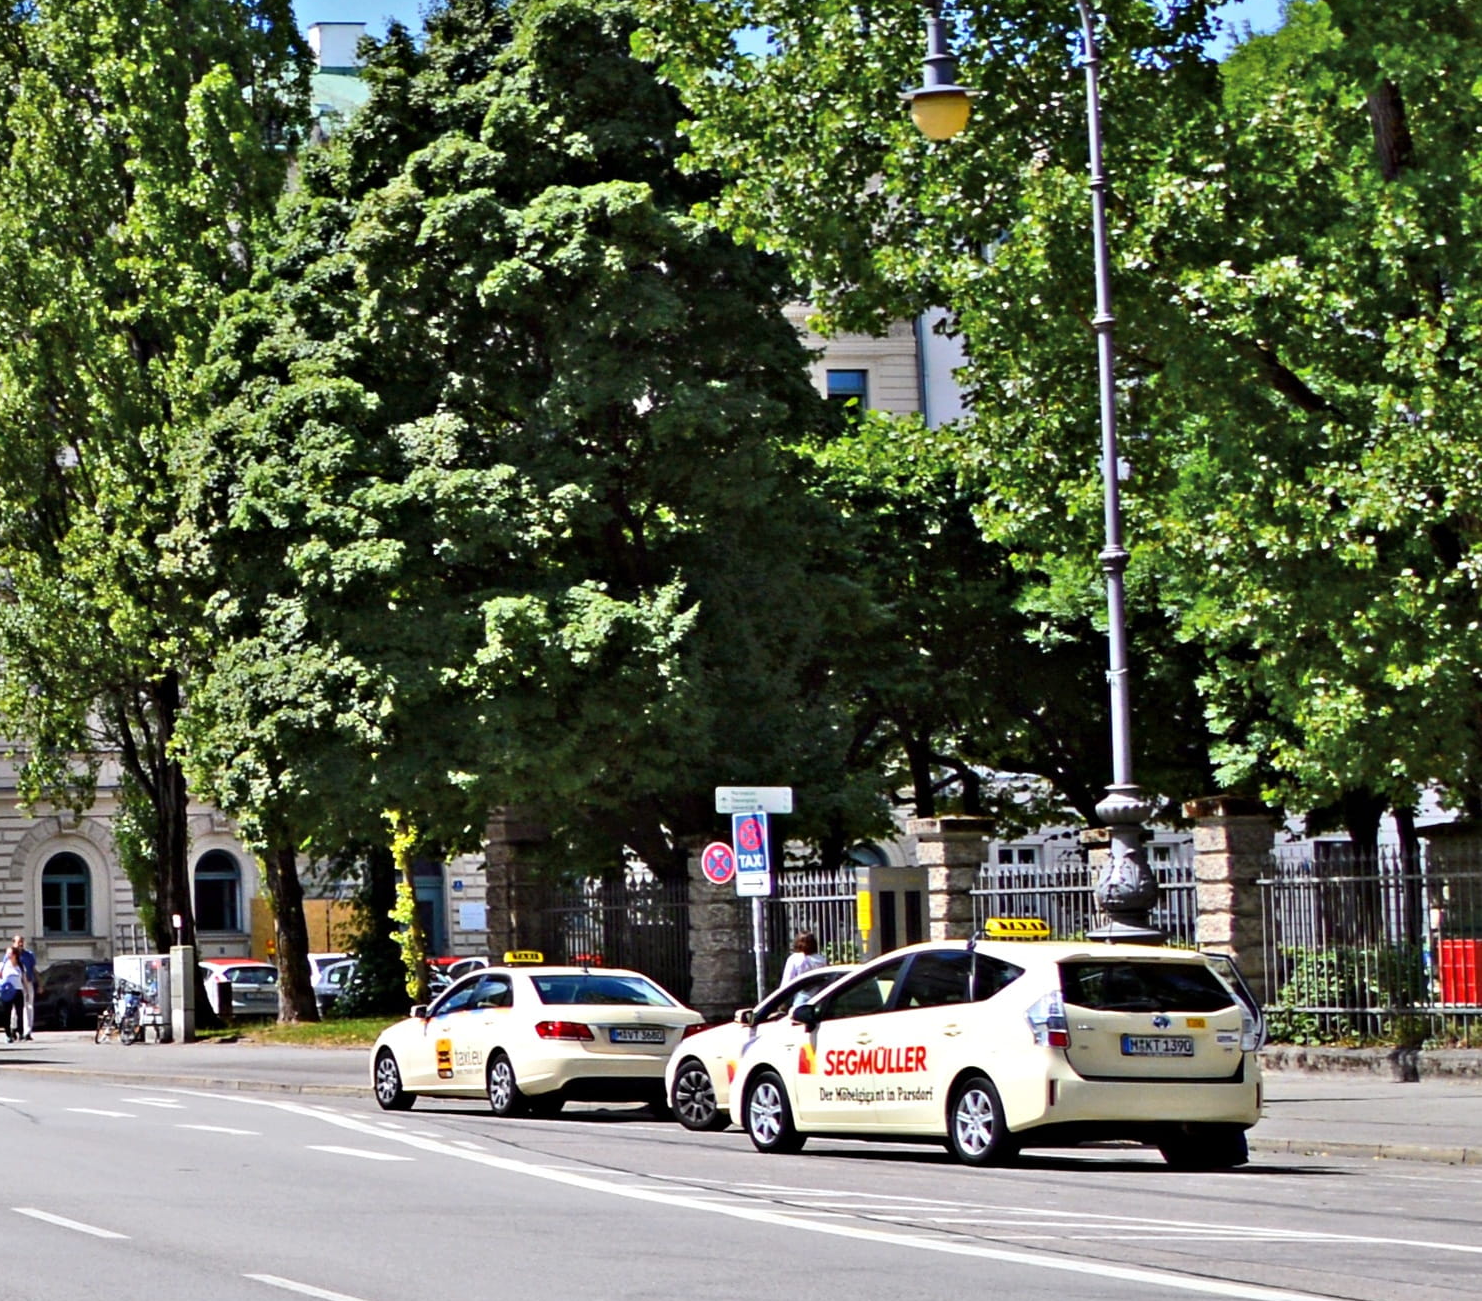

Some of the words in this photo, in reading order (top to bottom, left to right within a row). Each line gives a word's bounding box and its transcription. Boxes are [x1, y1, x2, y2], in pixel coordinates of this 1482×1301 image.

[738, 854, 764, 869] TAXI
[1163, 1039, 1192, 1052] 1390
[824, 1046, 927, 1076] SEGMÜLLER
[819, 1087, 833, 1101] Der
[835, 1087, 885, 1105] Möbelgigant
[887, 1087, 896, 1101] in
[897, 1086, 933, 1101] Parsdorf
